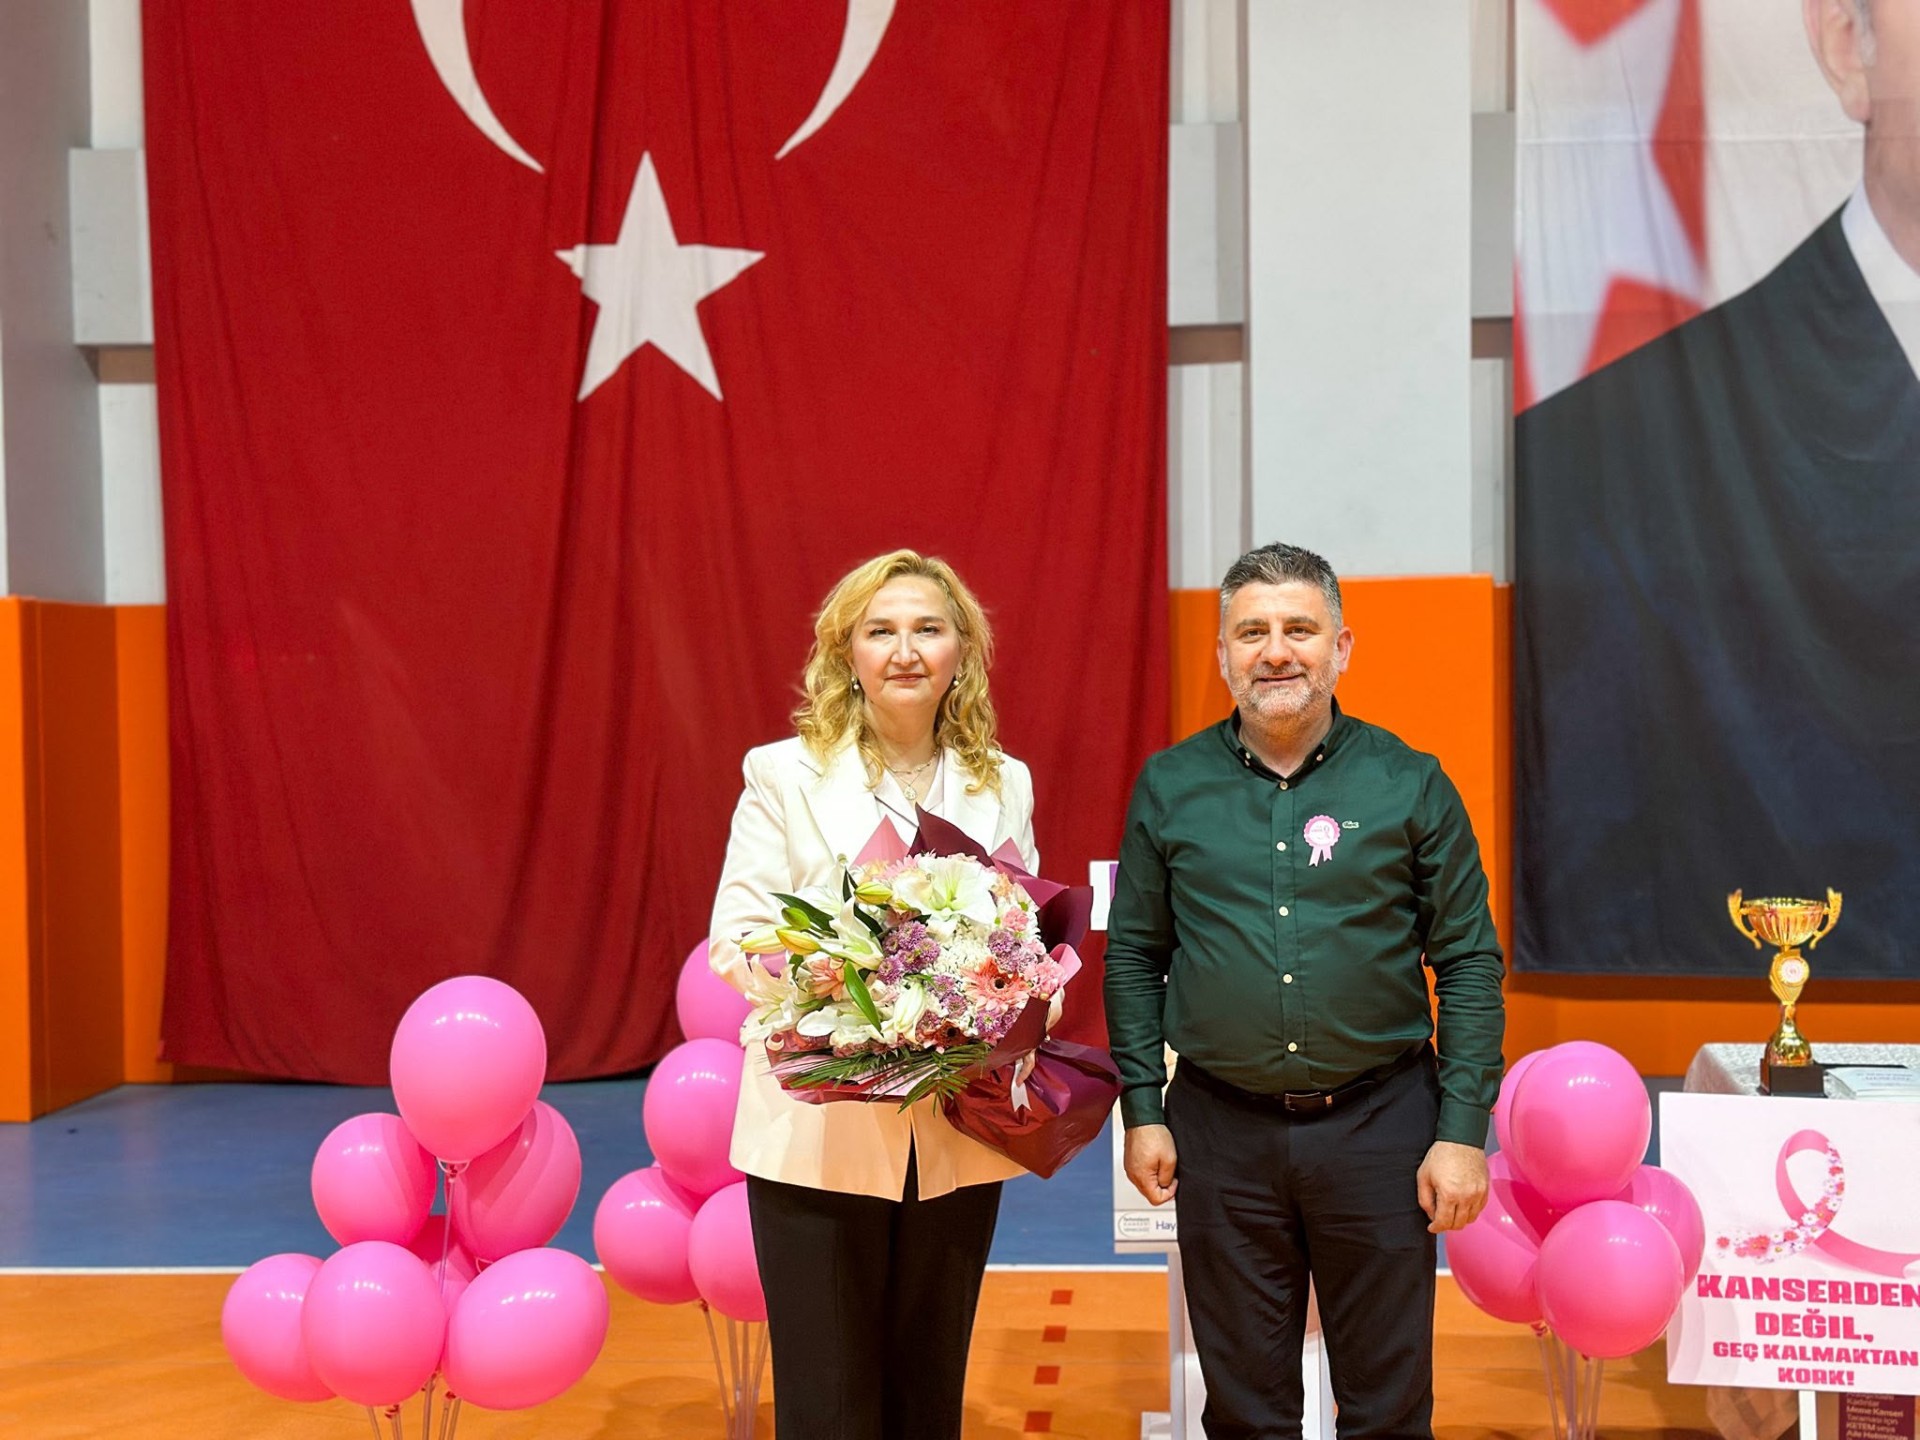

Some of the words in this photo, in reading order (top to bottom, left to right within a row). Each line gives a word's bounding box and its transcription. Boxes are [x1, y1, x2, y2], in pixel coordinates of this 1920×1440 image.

[1156, 1220, 1177, 1232] Hay
[1697, 1274, 1920, 1308] KANSERDEN
[1713, 1341, 1758, 1362] GEÇ
[1763, 1344, 1919, 1366] KALMAKTAN
[1778, 1367, 1855, 1386] KORK!
[1846, 1406, 1872, 1414] Meme
[1873, 1408, 1904, 1417] Kanseri
[1846, 1422, 1876, 1431] KETEM
